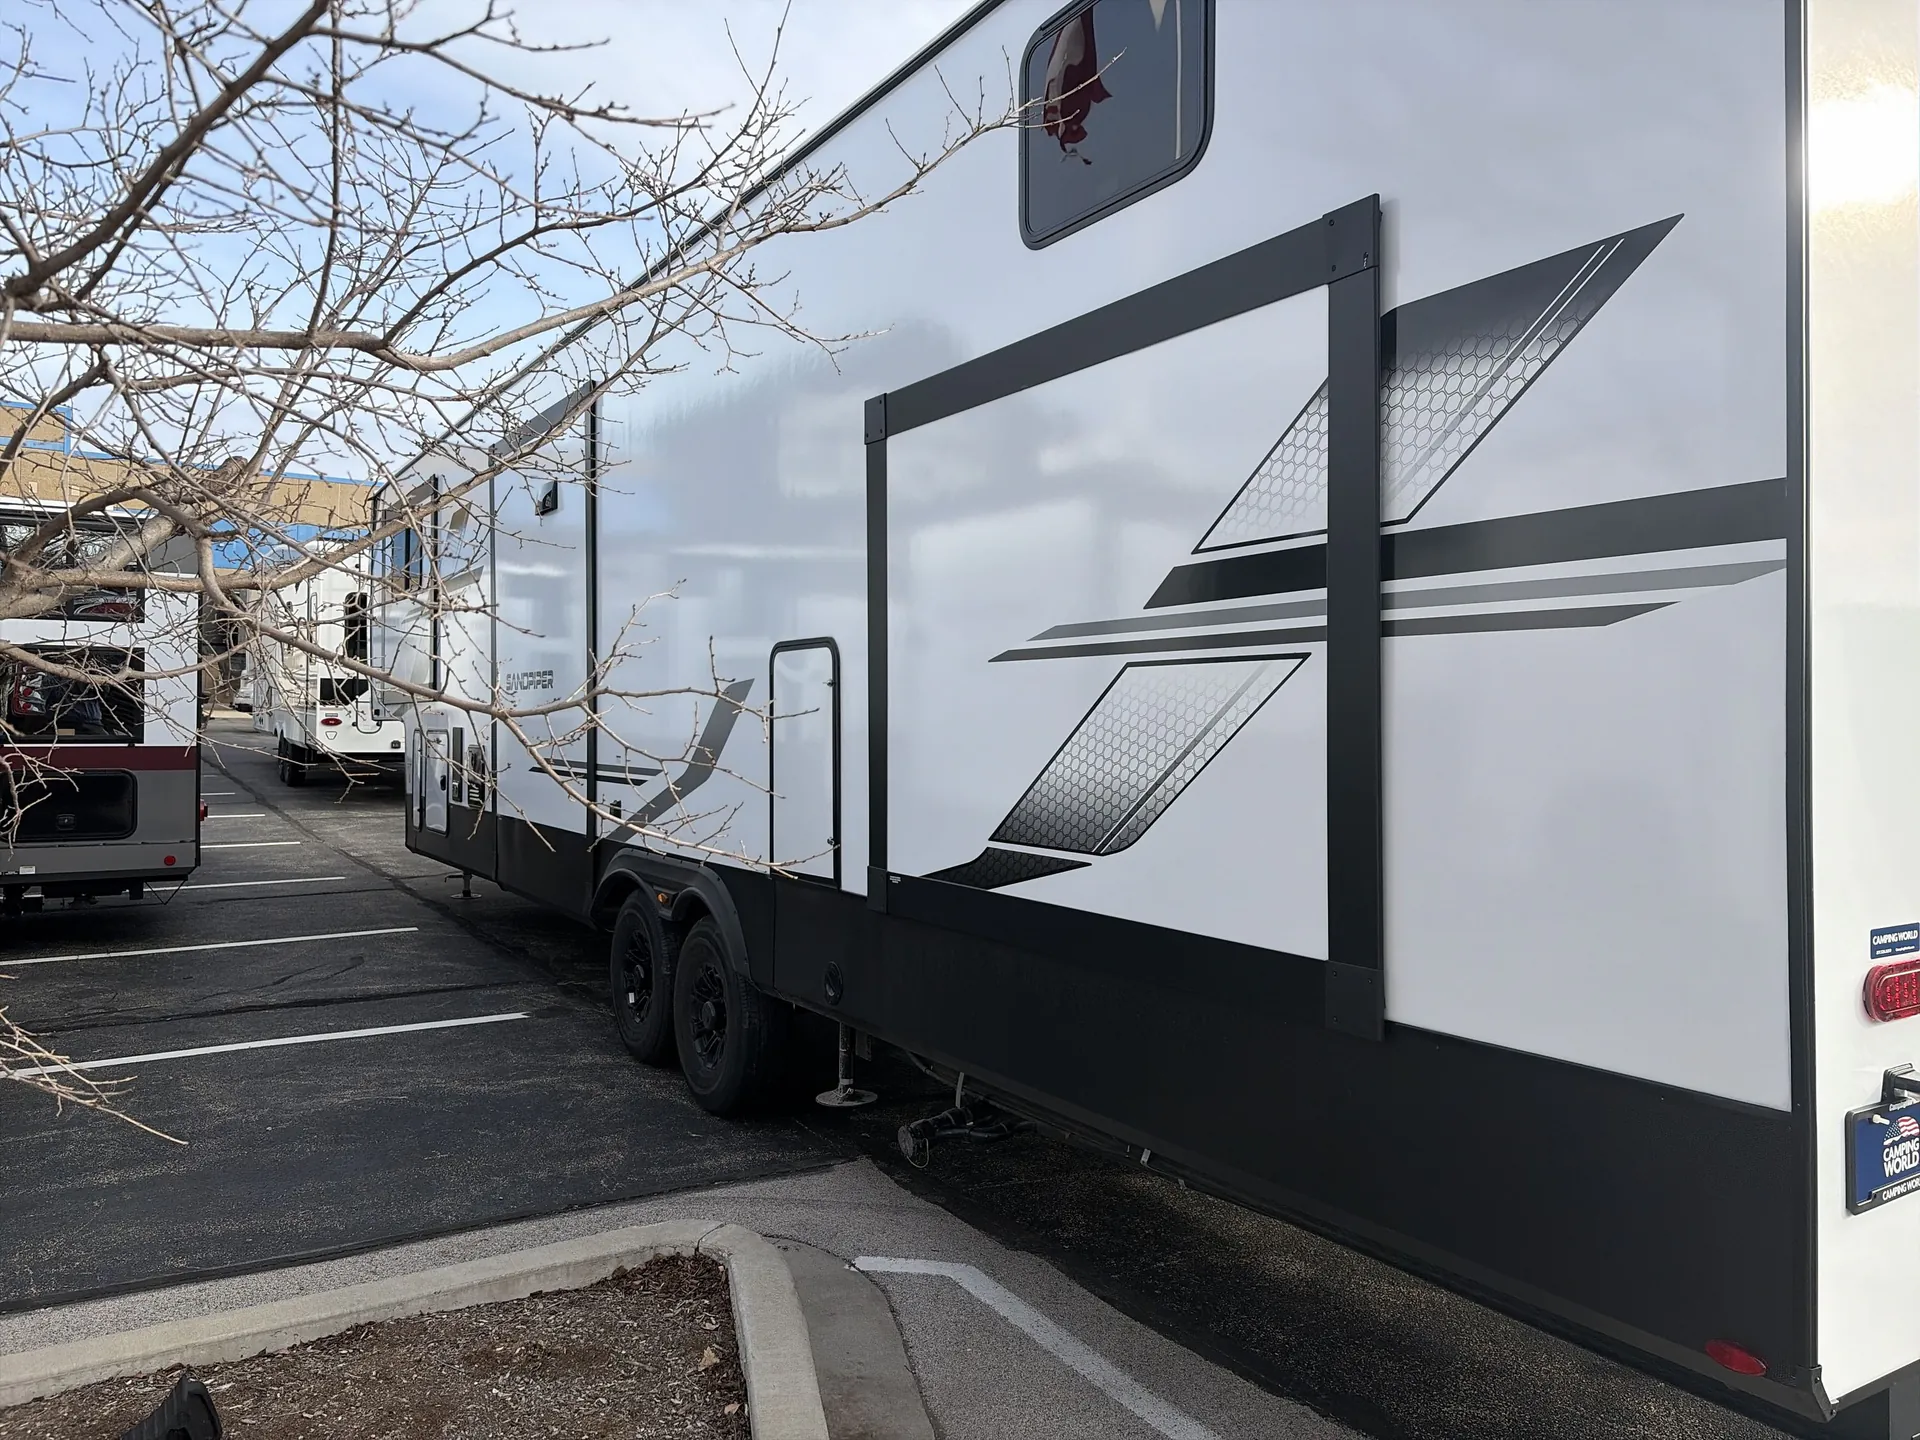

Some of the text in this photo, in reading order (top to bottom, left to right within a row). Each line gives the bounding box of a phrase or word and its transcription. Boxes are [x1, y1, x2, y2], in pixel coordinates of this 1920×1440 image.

[506, 670, 554, 690] SANDPIPER
[1873, 930, 1918, 945] CAMPING WORLD
[1883, 1138, 1919, 1161] CAMPING
[1883, 1151, 1919, 1177] WORLD
[1882, 1177, 1920, 1200] CAMPING WOR
